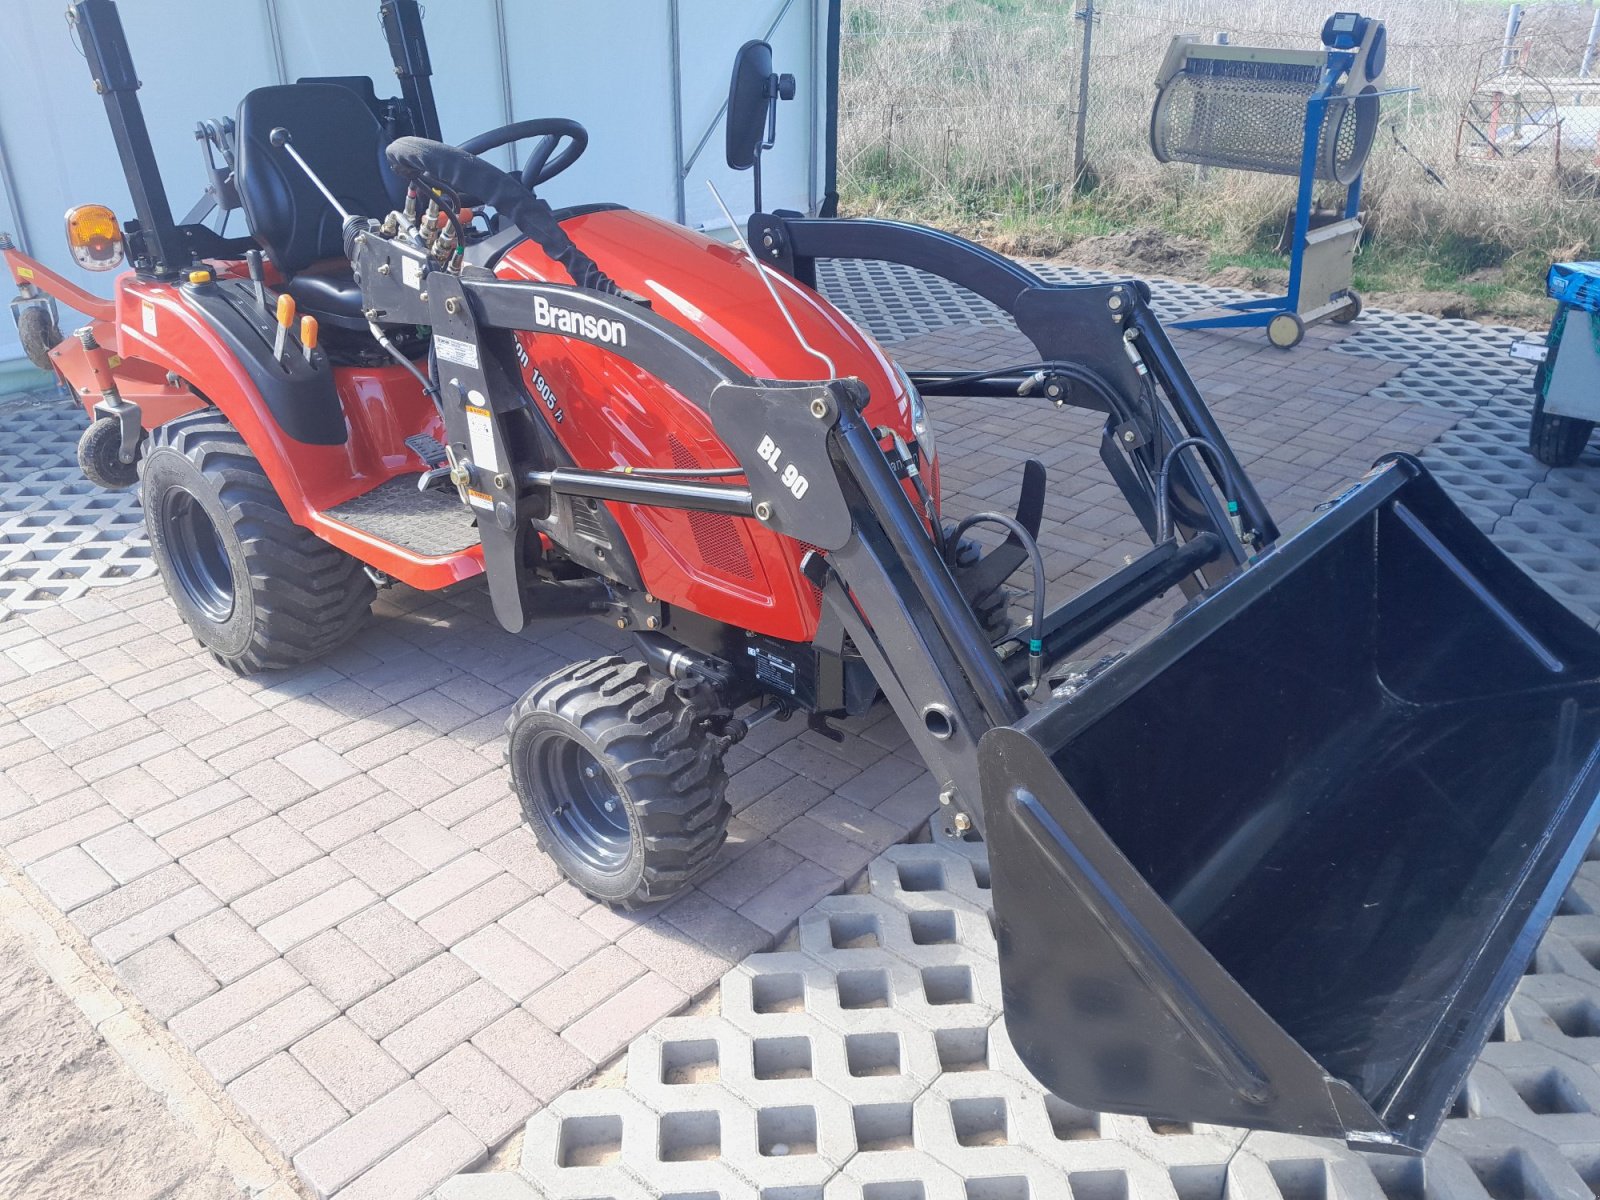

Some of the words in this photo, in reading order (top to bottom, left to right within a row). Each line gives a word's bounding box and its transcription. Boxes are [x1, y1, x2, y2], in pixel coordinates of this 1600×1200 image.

[534, 296, 626, 347] Branson
[532, 368, 557, 410] 1905
[757, 434, 782, 473] BL
[782, 464, 809, 499] 90
